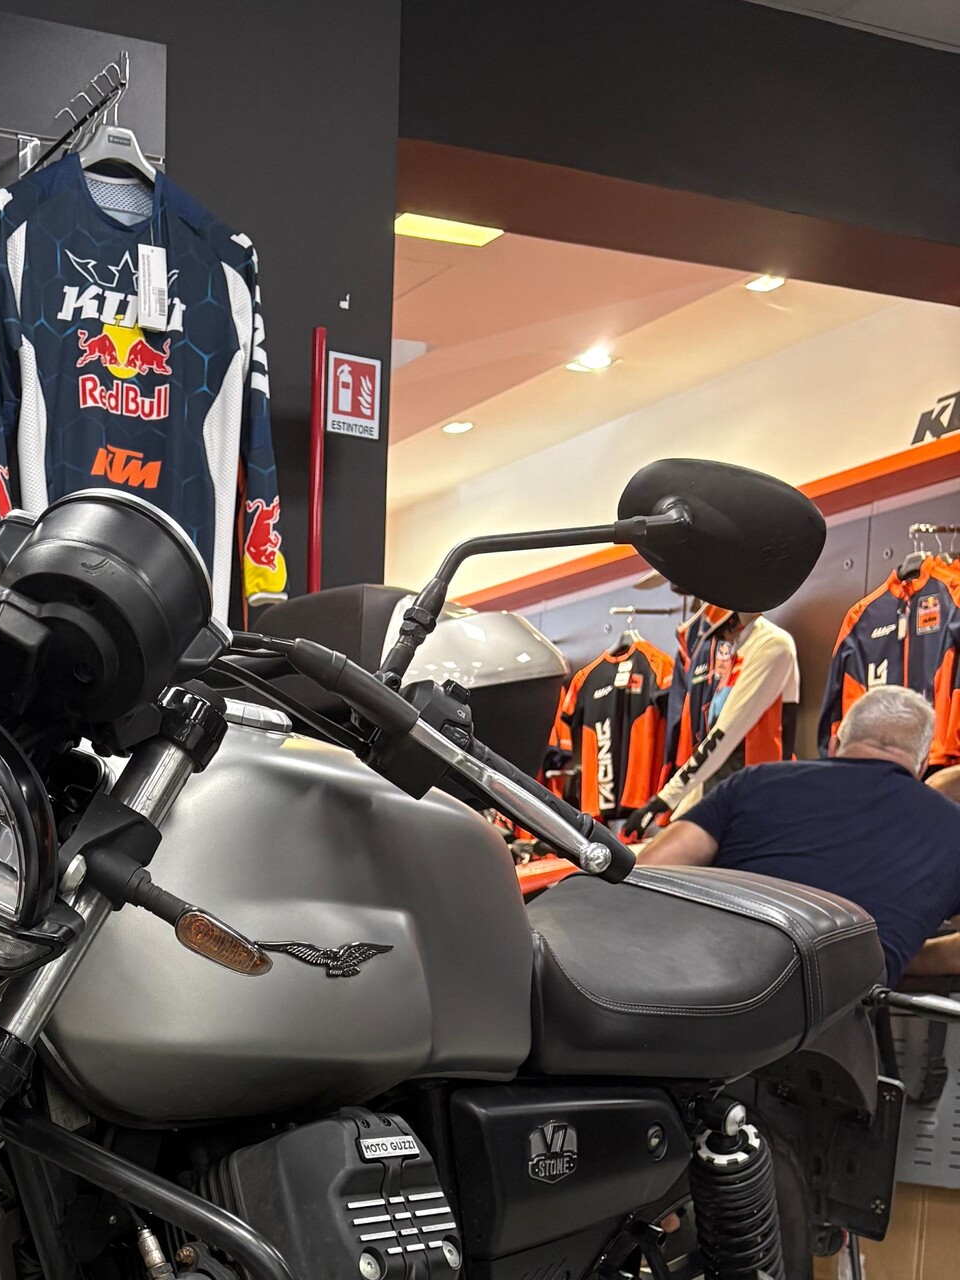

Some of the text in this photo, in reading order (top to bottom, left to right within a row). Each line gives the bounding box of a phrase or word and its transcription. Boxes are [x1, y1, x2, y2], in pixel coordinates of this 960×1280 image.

[79, 374, 170, 420] Red Bull
[331, 420, 375, 436] ESTINTORE
[91, 444, 162, 489] KTM
[364, 1140, 416, 1153] MOTO GUZZI
[540, 1122, 568, 1154] V7
[538, 1157, 570, 1177] STONE
